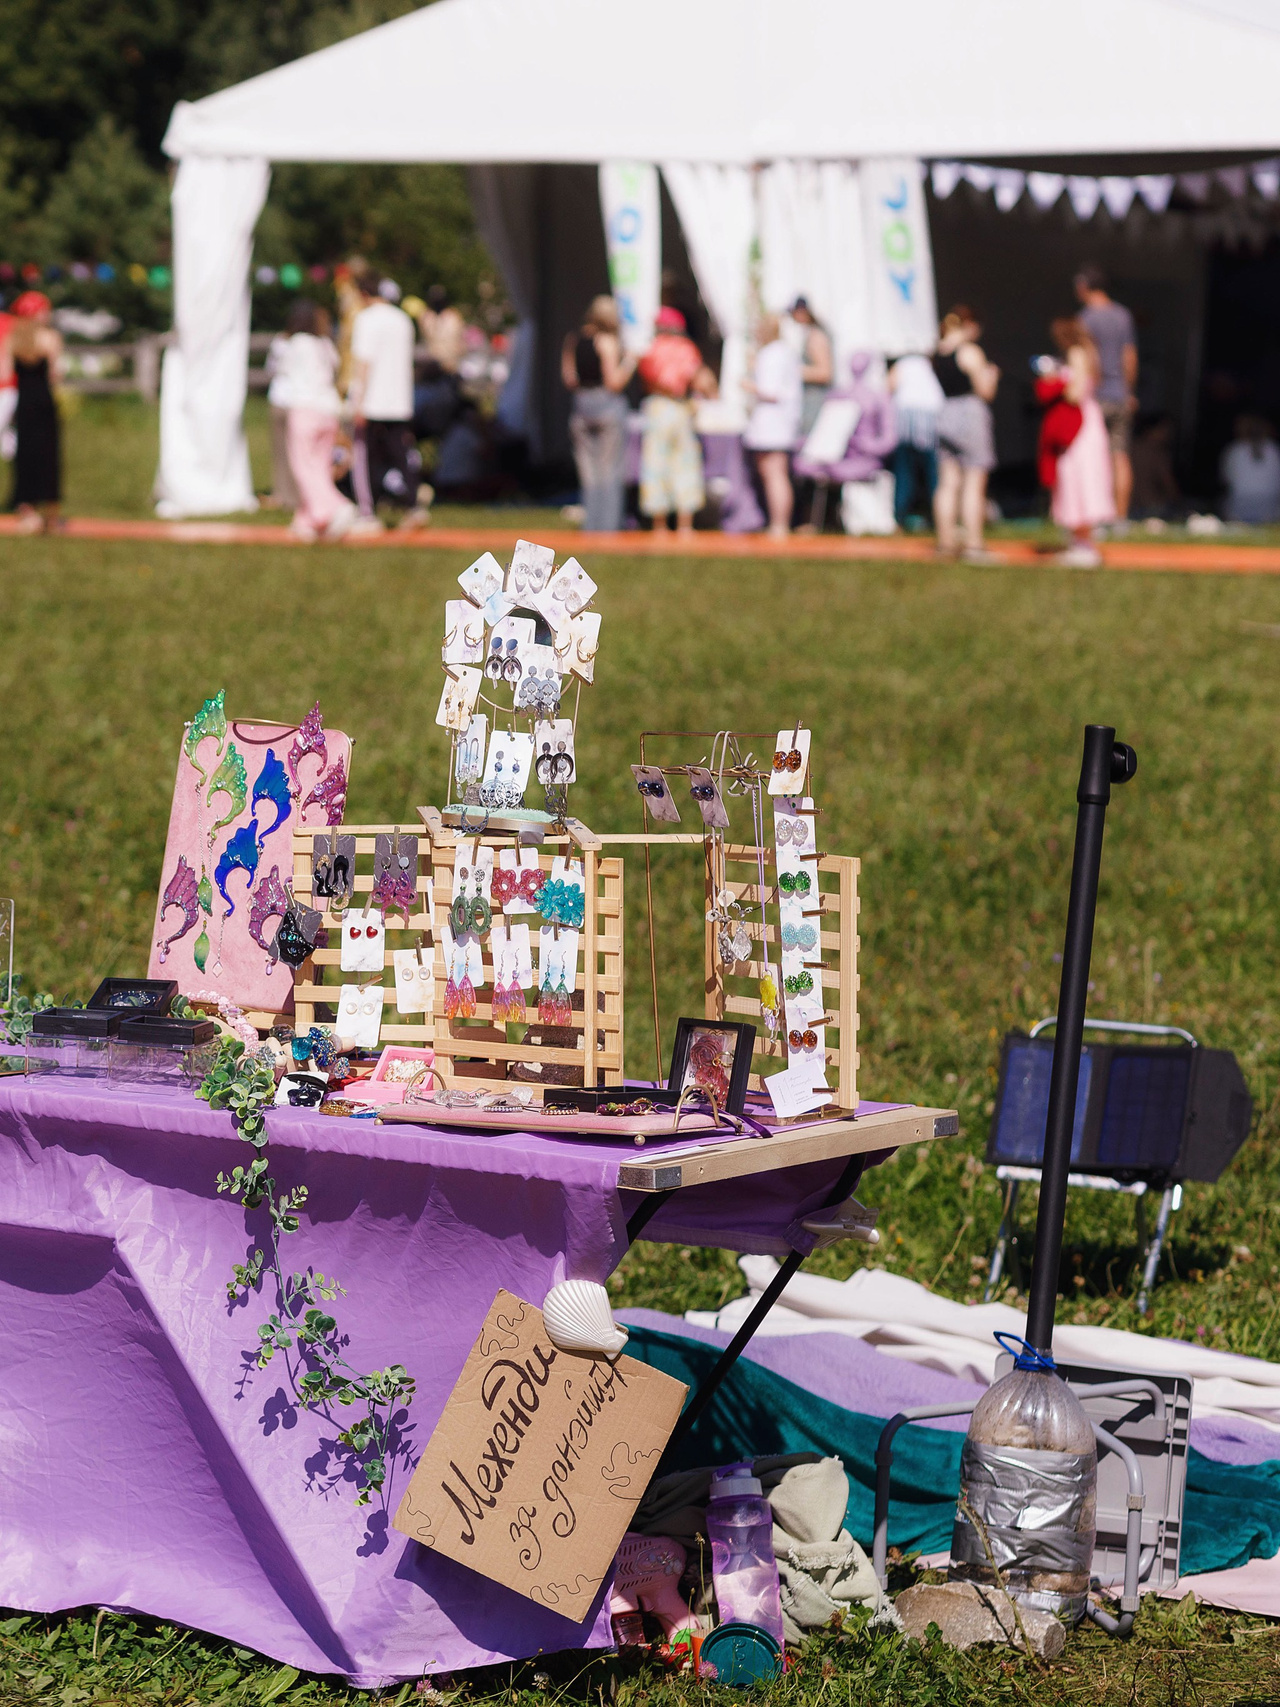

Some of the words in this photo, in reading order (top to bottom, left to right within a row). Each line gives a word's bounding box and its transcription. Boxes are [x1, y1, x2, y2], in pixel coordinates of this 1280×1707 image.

[880, 175, 915, 305] JOY
[441, 1343, 558, 1545] Мехенди
[509, 1505, 542, 1571] за
